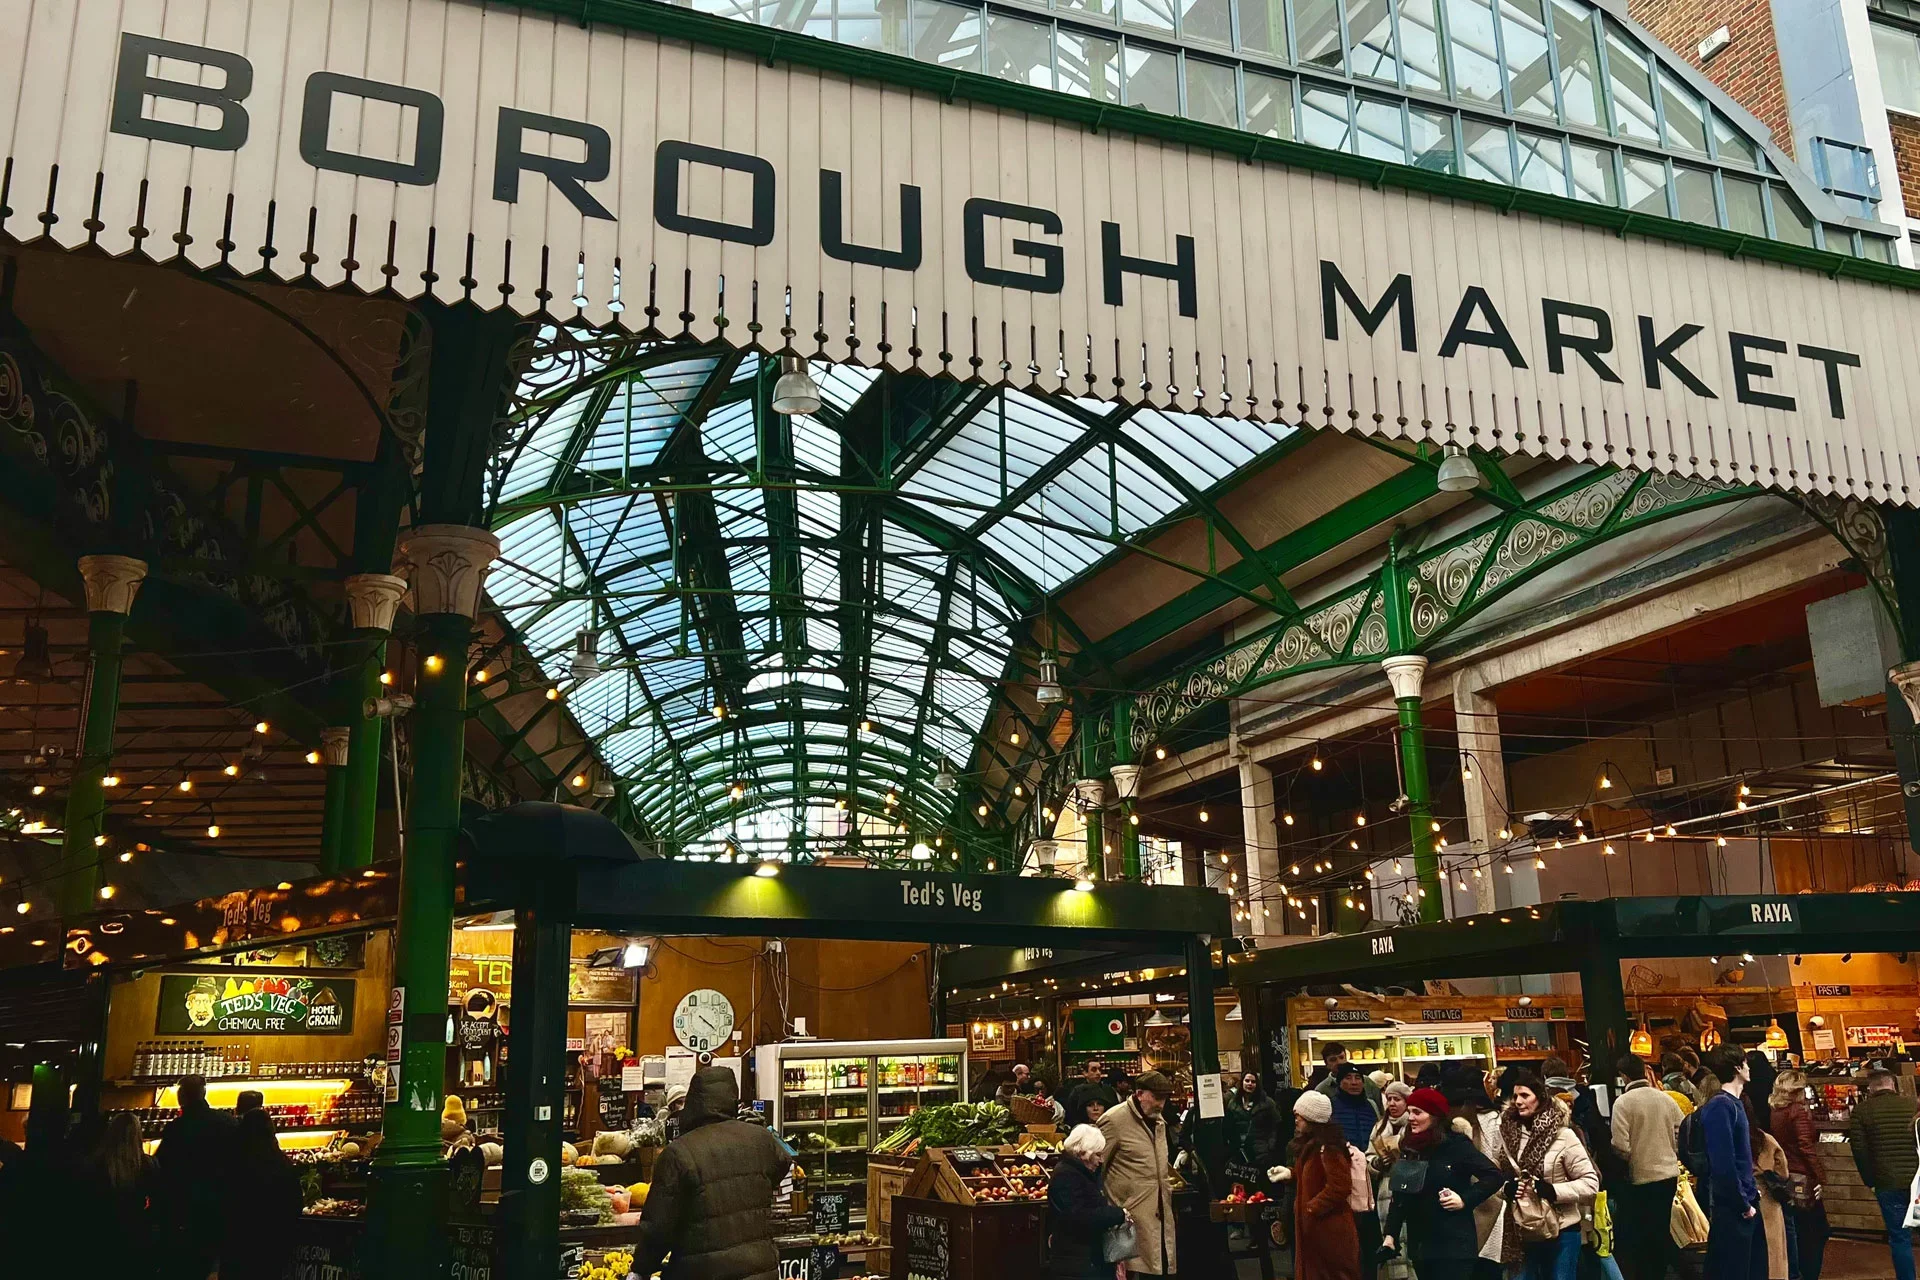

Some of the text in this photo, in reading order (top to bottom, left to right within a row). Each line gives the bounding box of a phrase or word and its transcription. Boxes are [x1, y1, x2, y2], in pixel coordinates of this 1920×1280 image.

[110, 32, 1860, 419] BOROUGH MARKET
[900, 880, 982, 912] Ted's Veg
[253, 898, 273, 924] Veg
[1751, 903, 1792, 922] RAYA
[1371, 935, 1395, 955] RAYA
[1818, 985, 1842, 996] PASTE
[221, 992, 297, 1015] TED'S VEG
[311, 1005, 335, 1015] HOME
[1329, 1011, 1349, 1021] HERBS
[1422, 1009, 1441, 1020] FRUIT
[1446, 1009, 1461, 1020] VEG
[1507, 1008, 1538, 1018] NOODLES
[218, 1017, 286, 1030] CHEMICAL FREE
[470, 1021, 490, 1029] ACCEPT
